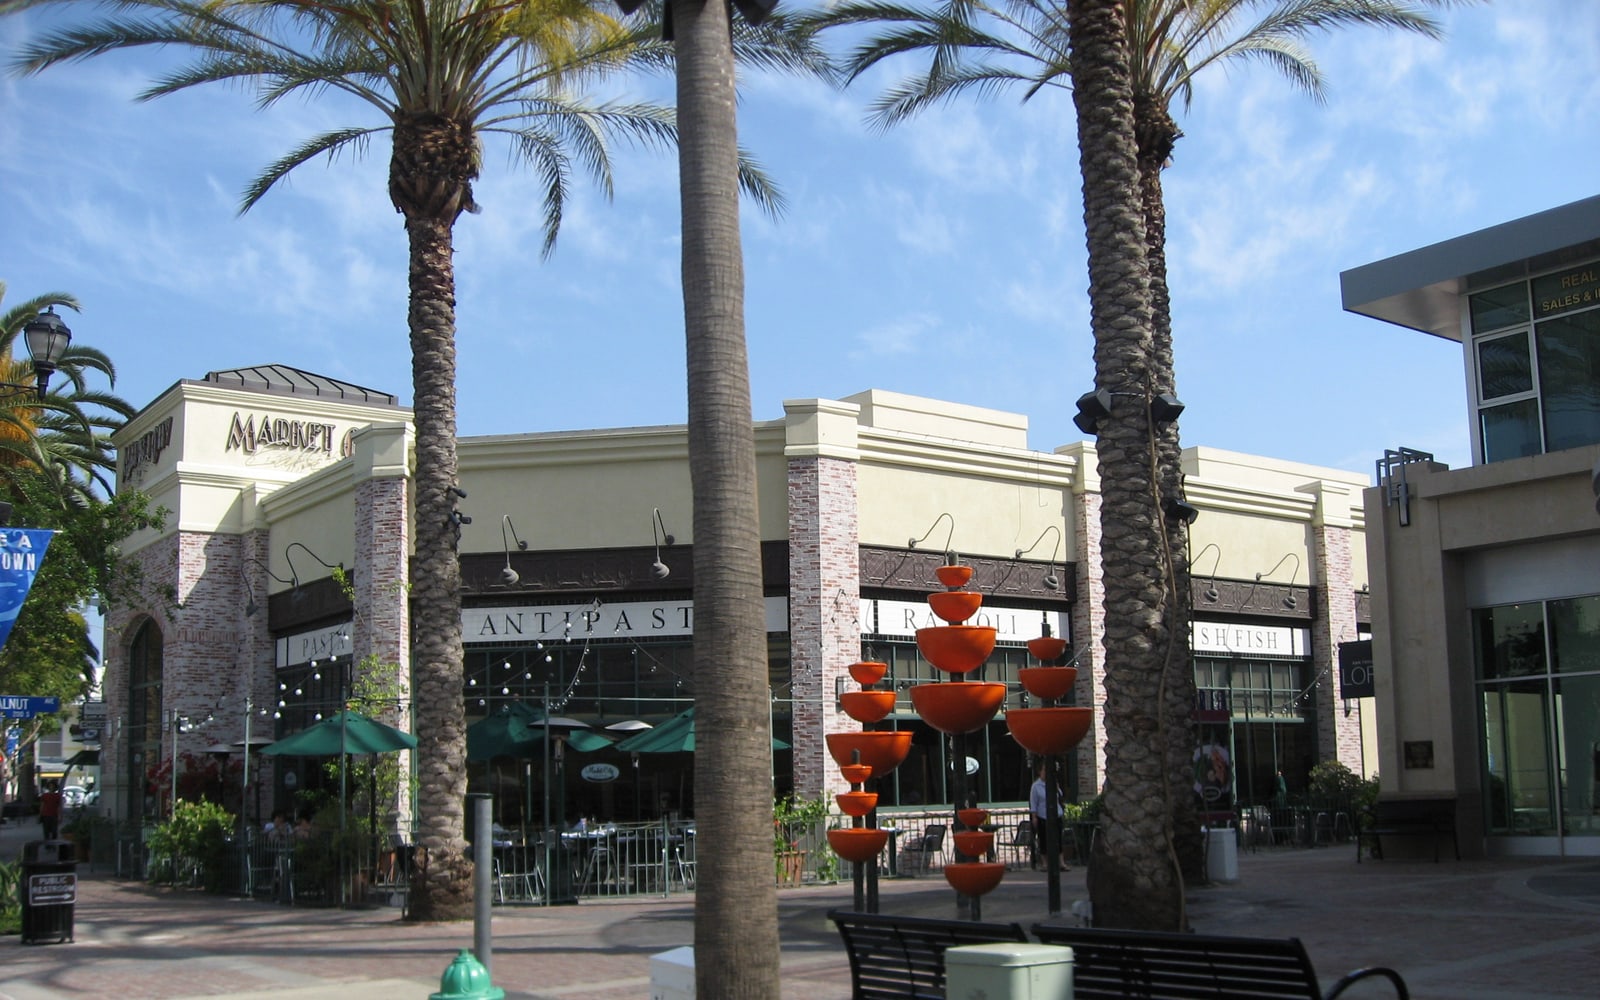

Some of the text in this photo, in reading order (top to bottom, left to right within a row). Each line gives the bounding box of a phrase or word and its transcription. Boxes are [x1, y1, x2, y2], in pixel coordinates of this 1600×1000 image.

[1561, 271, 1597, 288] REAL
[1542, 294, 1581, 312] SALES
[1583, 291, 1592, 302] &
[226, 411, 337, 455] MARKET
[0, 552, 36, 571] OWN
[479, 606, 694, 636] ANTIPAST
[904, 608, 1017, 636] RAOLI
[302, 630, 345, 658] PASTA
[1236, 629, 1278, 649] FISH
[39, 877, 66, 885] PUBLIC
